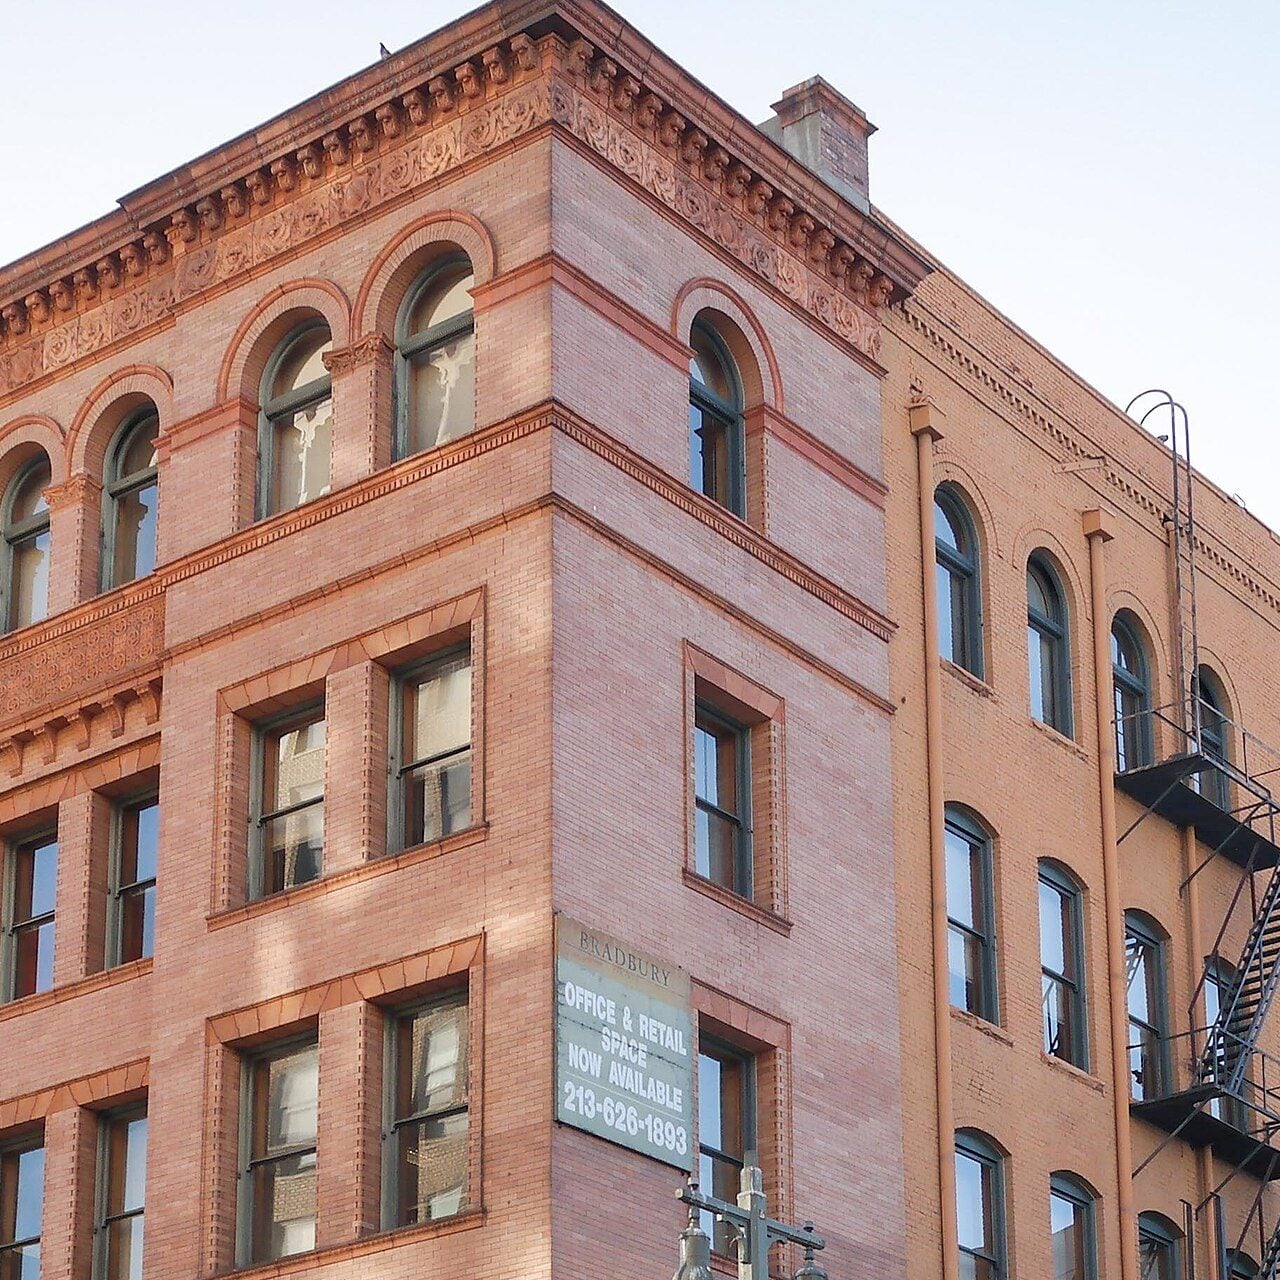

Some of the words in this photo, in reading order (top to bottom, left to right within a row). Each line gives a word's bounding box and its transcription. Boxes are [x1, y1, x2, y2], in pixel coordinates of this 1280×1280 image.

[579, 930, 670, 987] BRADBURY
[564, 981, 616, 1025] OFFICE
[622, 1006, 633, 1033] &
[639, 1013, 687, 1056] RETAIL
[601, 1026, 648, 1068] SPACE
[569, 1043, 602, 1079] NOW
[608, 1061, 683, 1113] AVAILABLE
[564, 1081, 687, 1155] 213-626-1893
